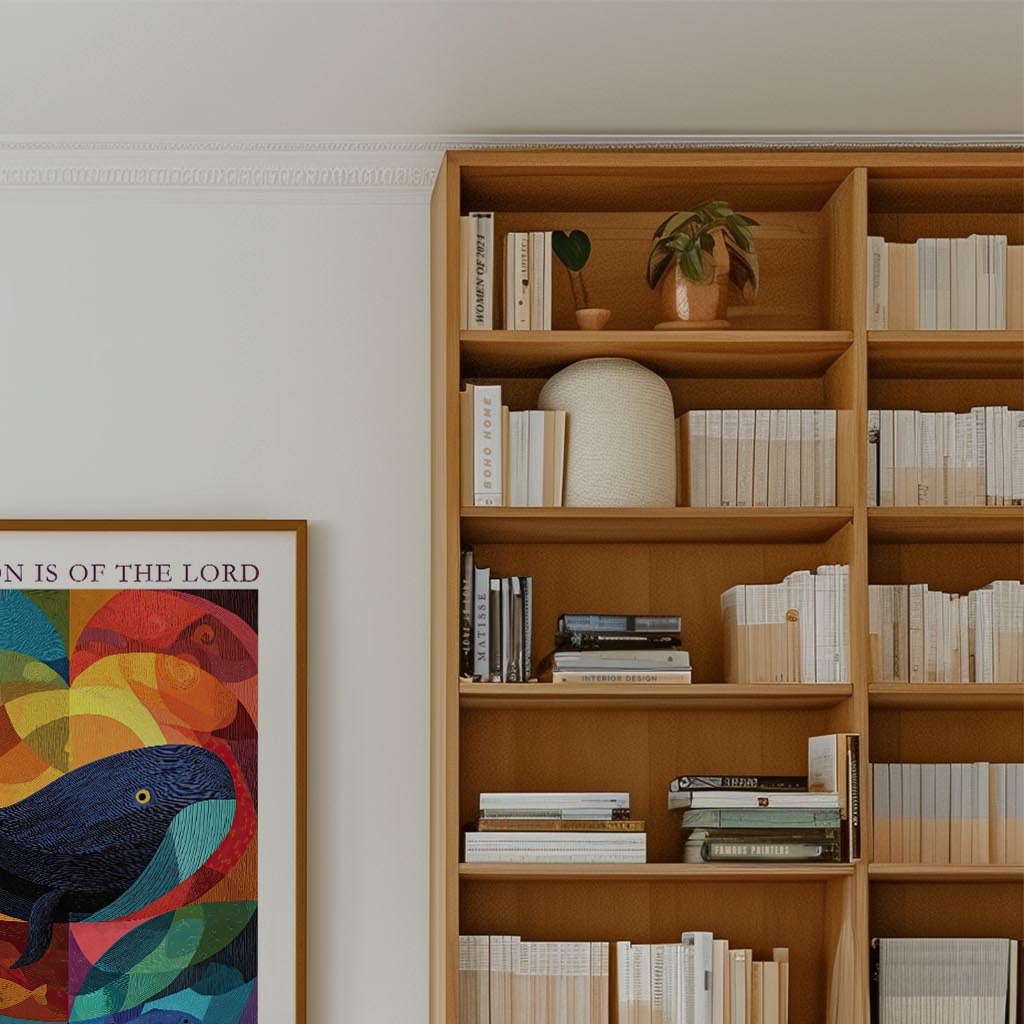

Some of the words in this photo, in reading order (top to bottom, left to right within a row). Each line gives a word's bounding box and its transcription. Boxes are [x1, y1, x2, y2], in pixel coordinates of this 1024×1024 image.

[476, 258, 485, 275] OF
[476, 277, 485, 323] WOMEN
[483, 397, 492, 440] HOME
[483, 447, 492, 489] BOHO
[34, 563, 58, 583] IS
[69, 563, 106, 583] OF
[115, 563, 173, 583] THE
[182, 563, 260, 583] LORD
[477, 593, 487, 661] MATISSE
[582, 674, 622, 682] INTERIOR
[625, 674, 657, 682] DESIGN
[714, 845, 747, 855] FAMOUS
[751, 845, 789, 855] PAINTERS
